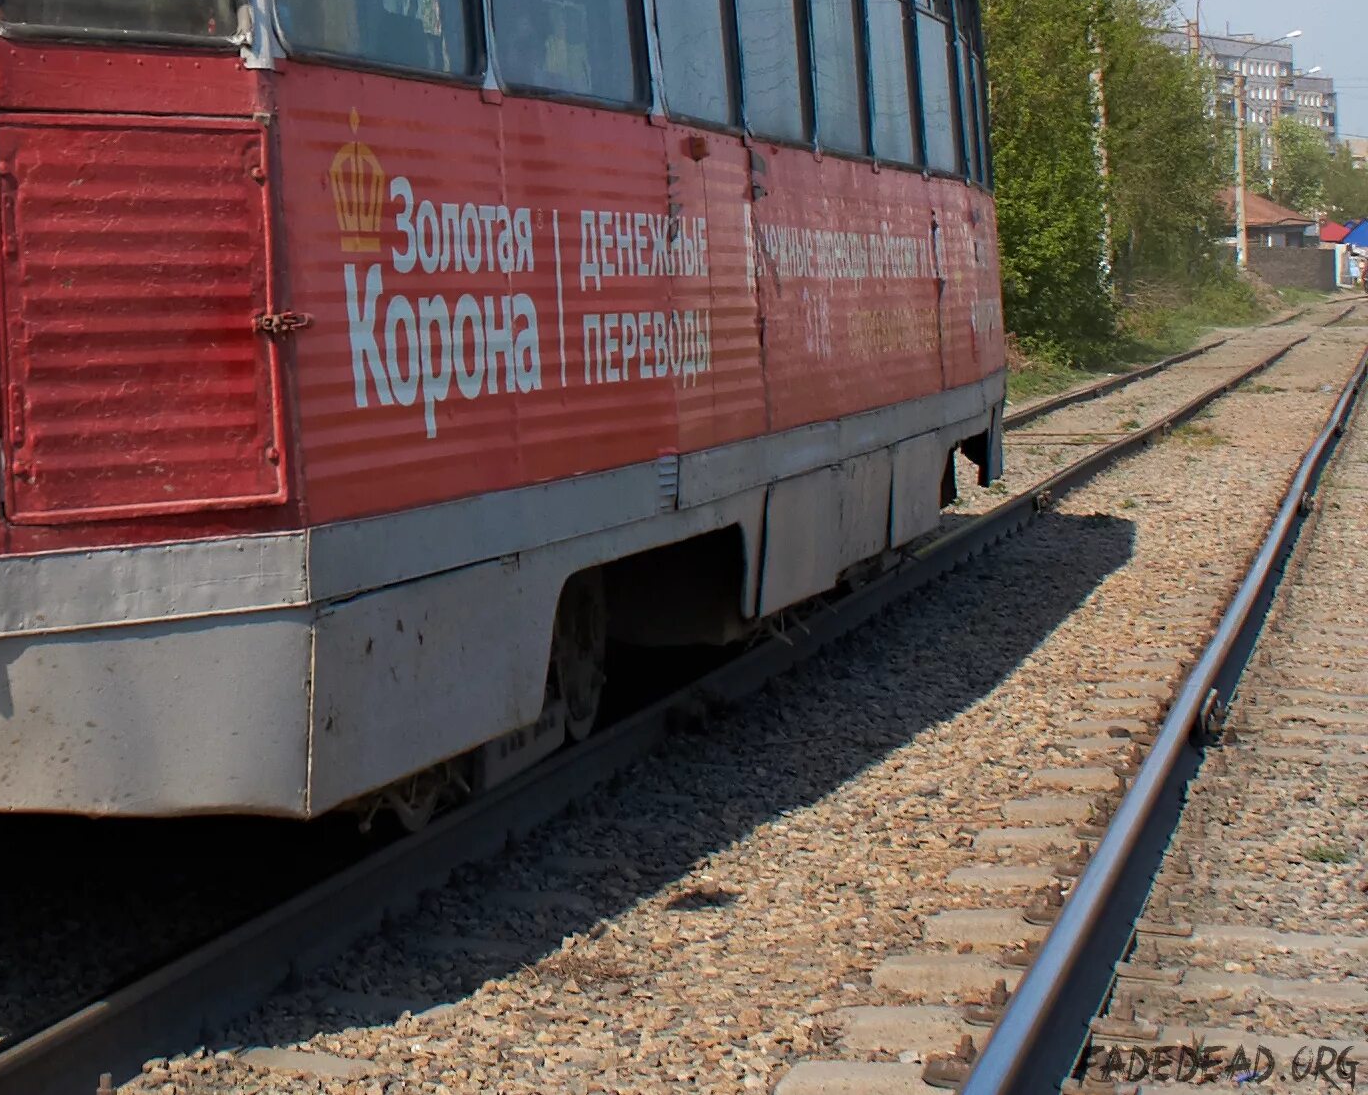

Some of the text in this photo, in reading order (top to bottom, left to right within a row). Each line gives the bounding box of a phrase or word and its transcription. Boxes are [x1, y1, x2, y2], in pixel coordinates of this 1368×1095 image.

[389, 176, 534, 274] Золотая
[580, 209, 708, 292] ДЕНЕЖНЫЕ
[344, 263, 542, 439] Корона
[583, 309, 711, 388] ПЕРЕВОДЫ
